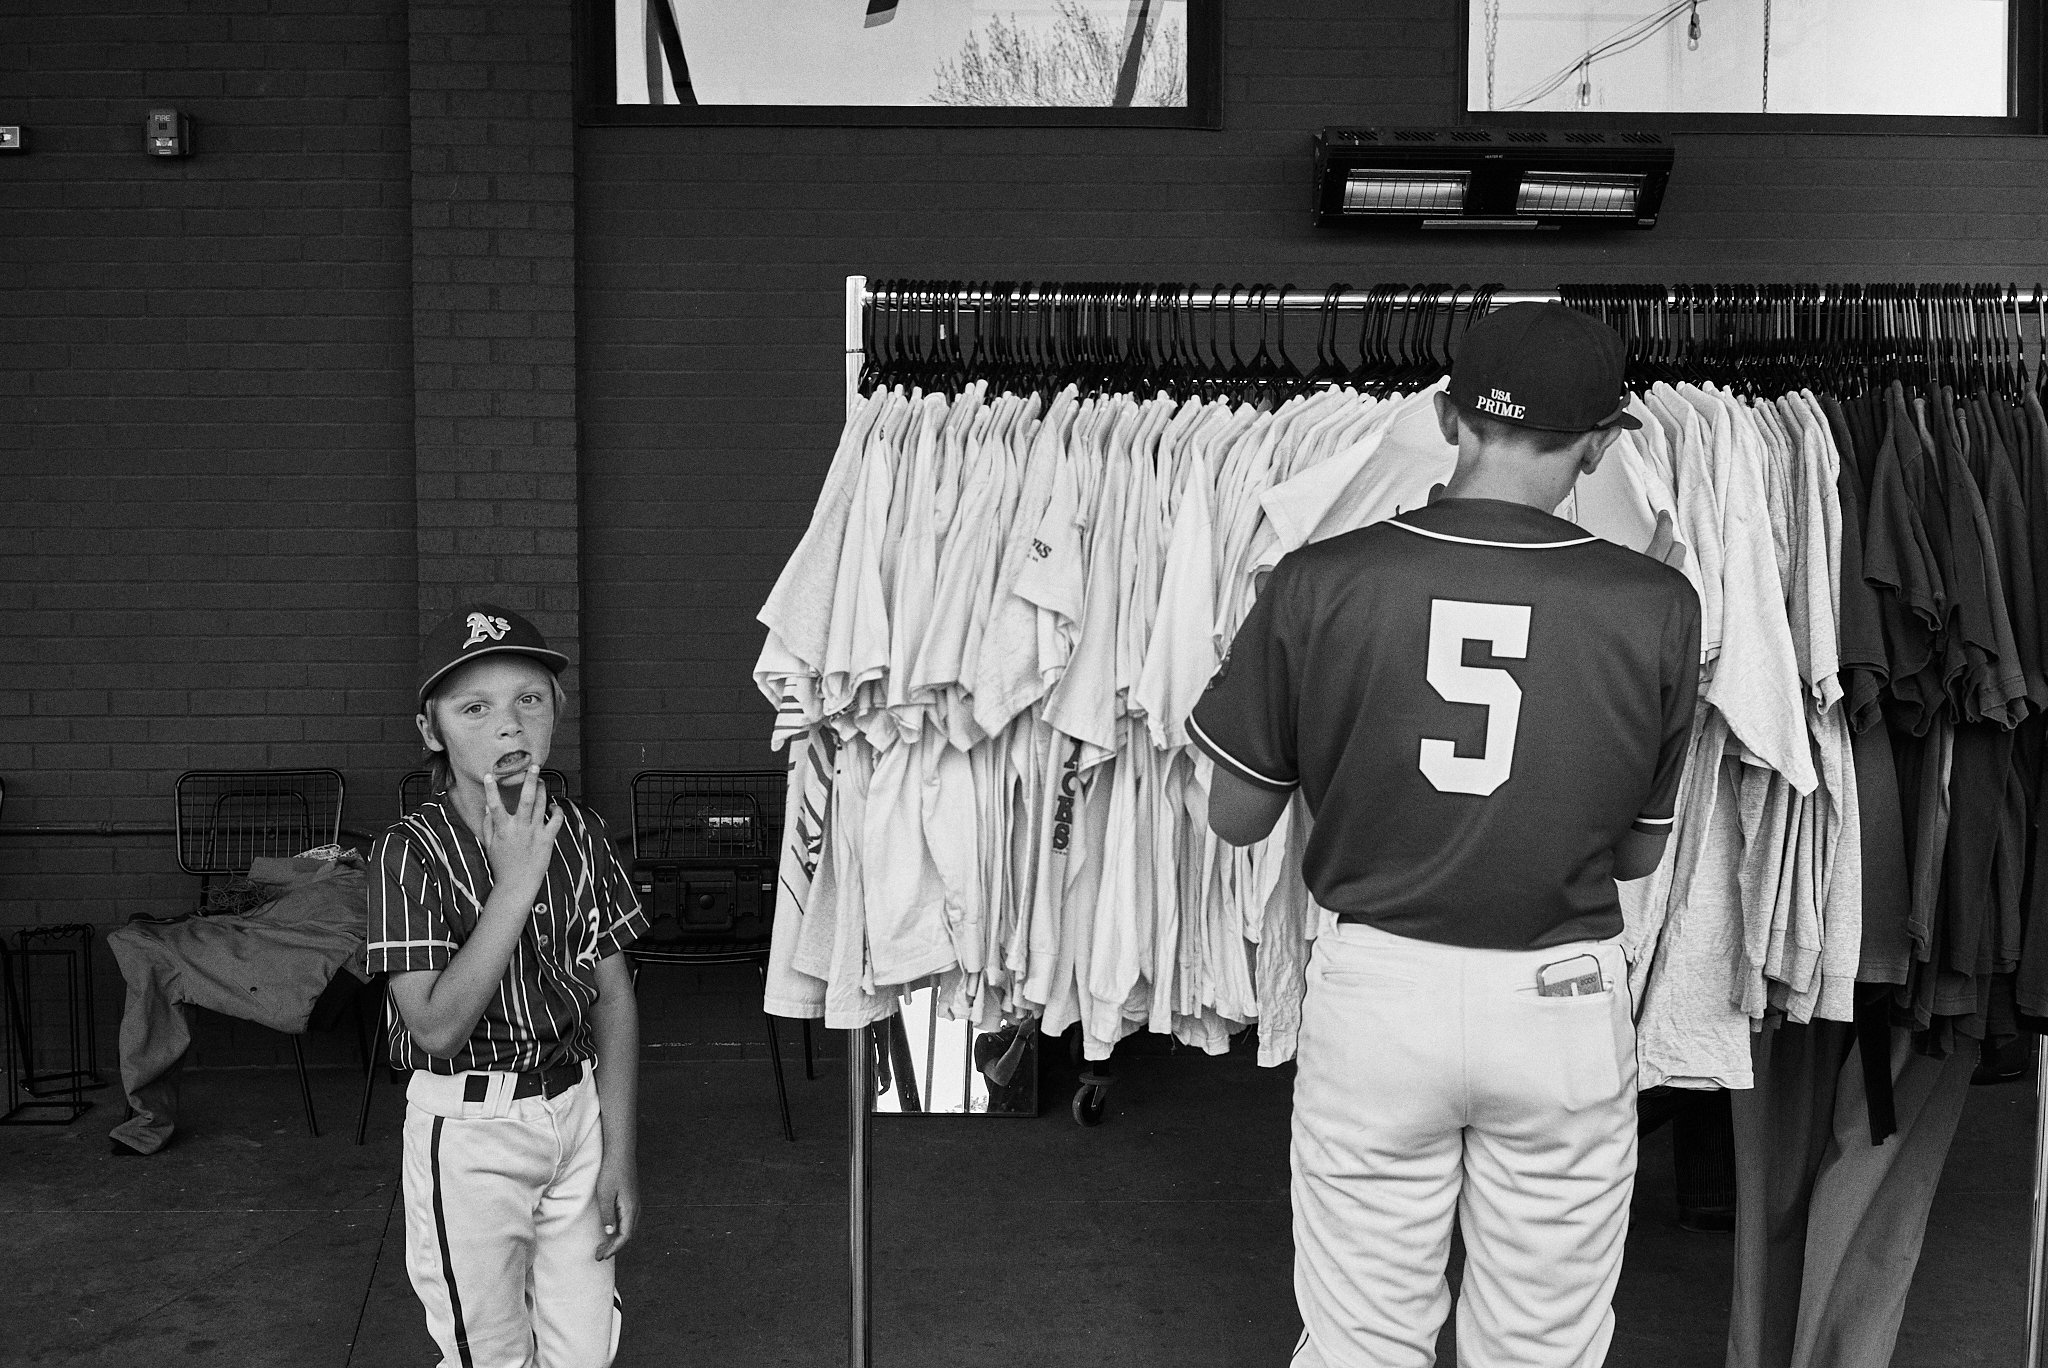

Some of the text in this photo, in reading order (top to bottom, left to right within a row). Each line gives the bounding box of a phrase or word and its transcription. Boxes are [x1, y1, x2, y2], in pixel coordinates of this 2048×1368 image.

[154, 114, 171, 122] FIRE
[1491, 388, 1512, 403] USA
[1475, 395, 1526, 420] PRIME
[1419, 598, 1532, 797] 5
